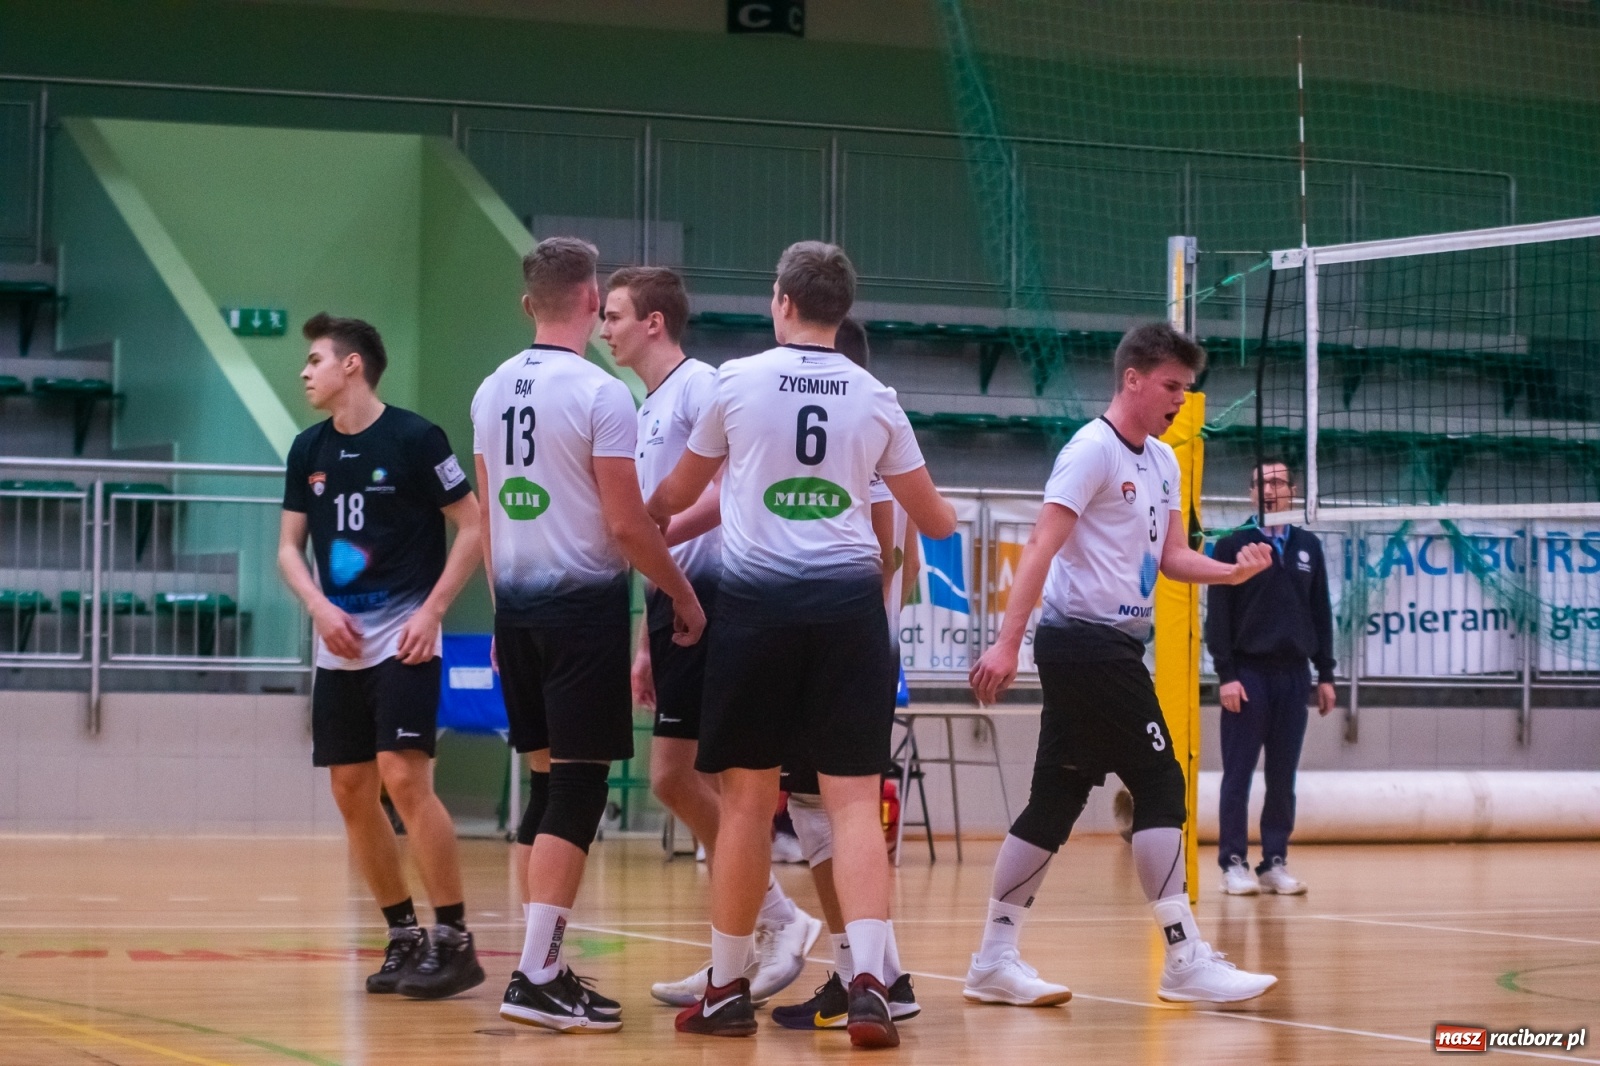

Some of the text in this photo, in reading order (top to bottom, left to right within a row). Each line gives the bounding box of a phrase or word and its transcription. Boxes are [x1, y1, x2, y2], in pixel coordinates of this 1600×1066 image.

[738, 3, 772, 28] C
[515, 378, 536, 398] BĄK
[779, 375, 849, 396] ZYGMUNT
[501, 405, 536, 467] 13
[795, 404, 829, 466] 6
[333, 493, 365, 531] 18
[773, 492, 841, 507] MIKI
[1149, 506, 1158, 542] 3
[899, 622, 925, 644] at
[1146, 721, 1166, 751] 3
